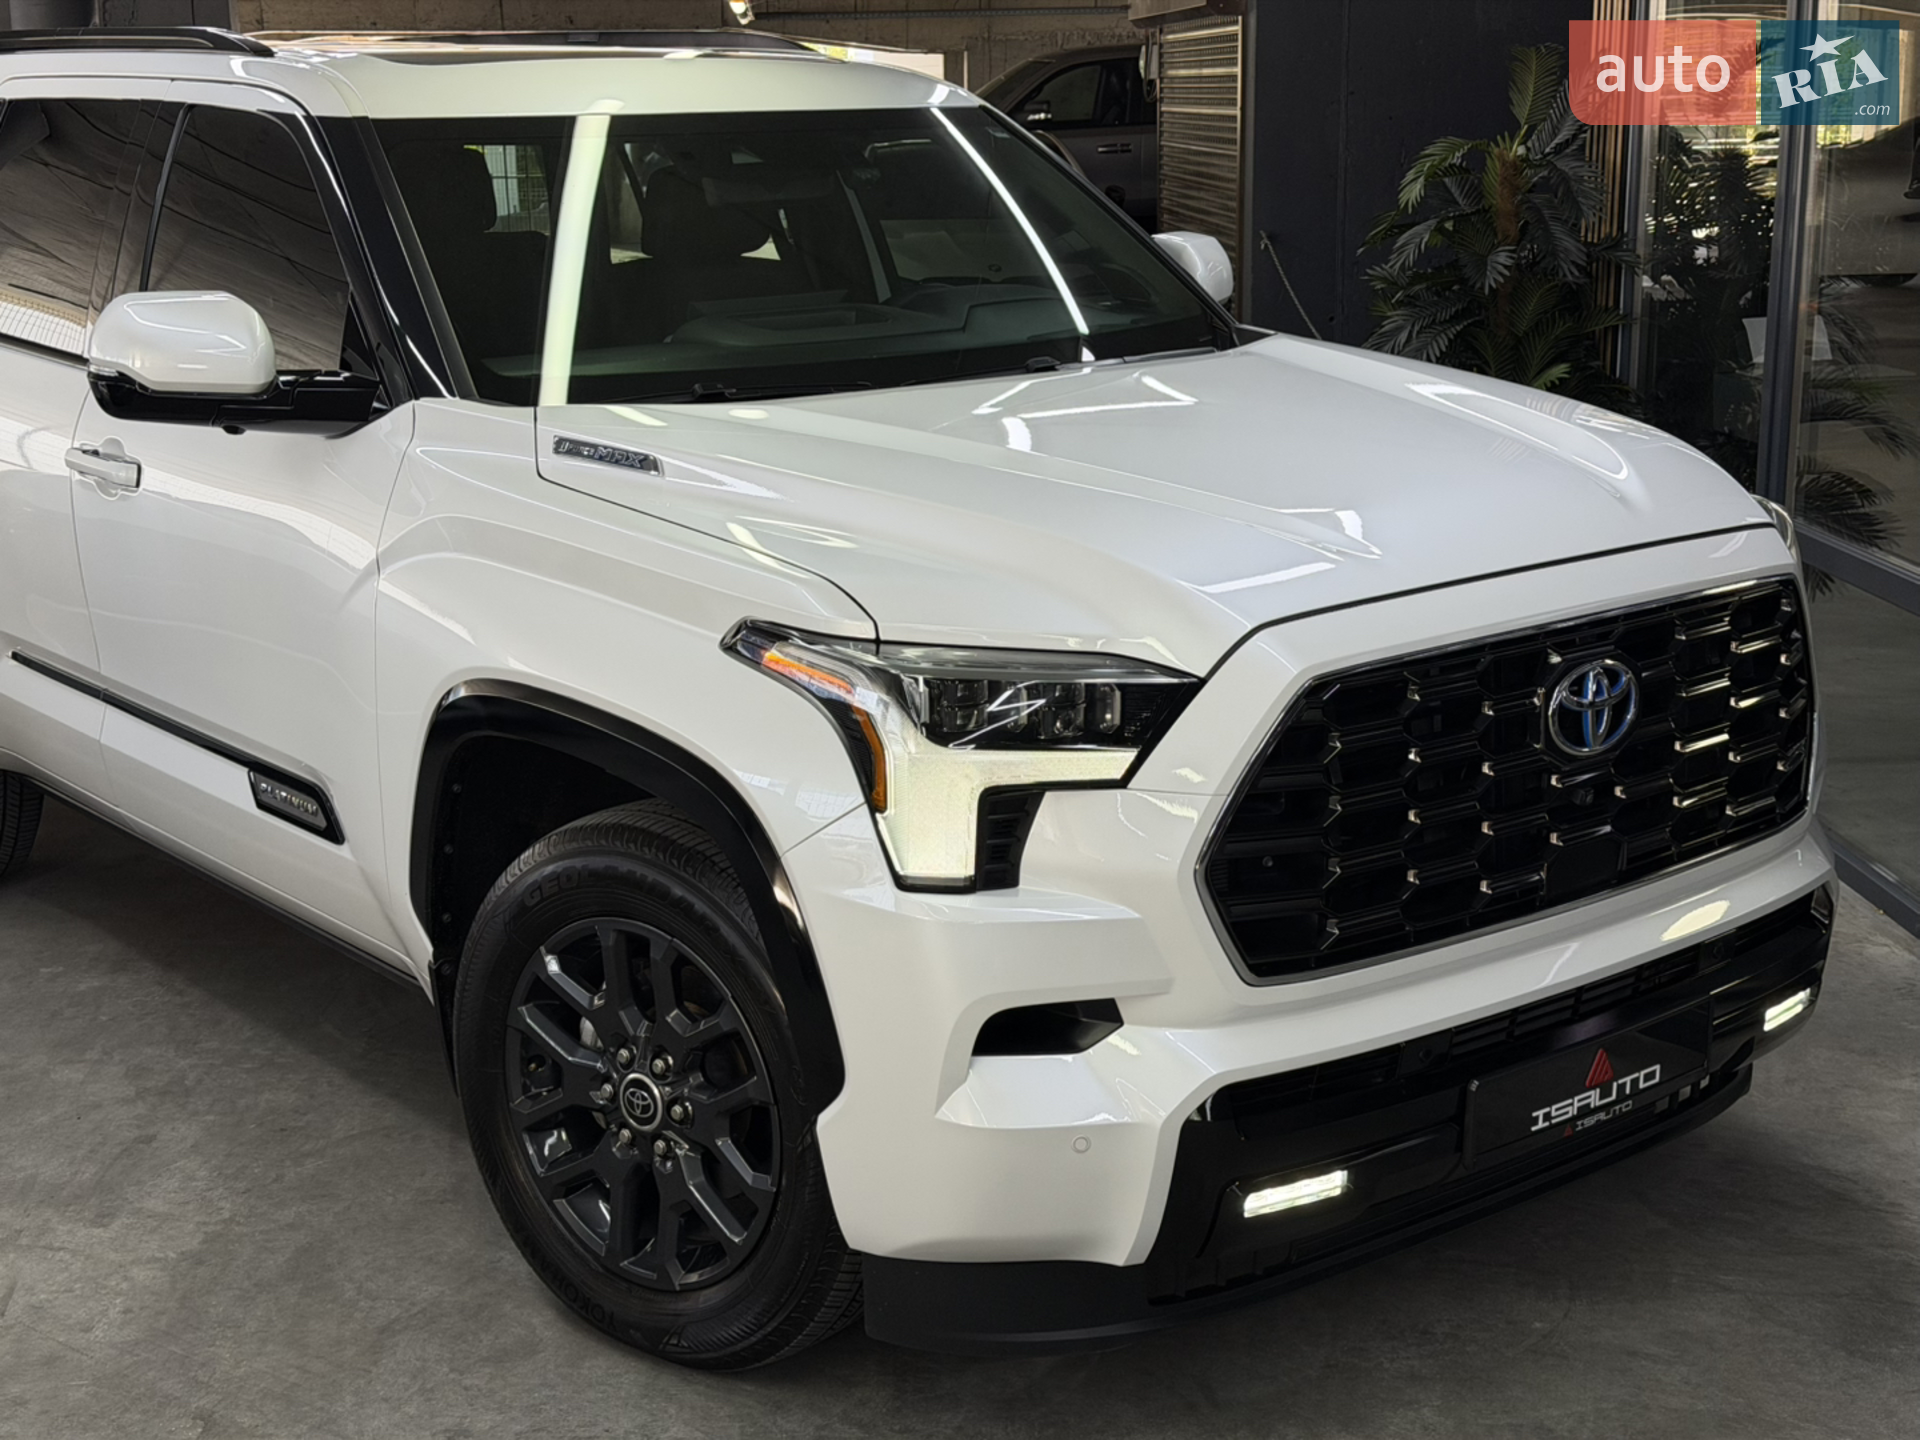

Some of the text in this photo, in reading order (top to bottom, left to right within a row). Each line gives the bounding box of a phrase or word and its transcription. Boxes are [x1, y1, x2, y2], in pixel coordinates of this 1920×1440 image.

[594, 446, 644, 467] MAX
[1531, 1064, 1661, 1132] ISAUTO
[1575, 1100, 1633, 1132] ISAUTO
